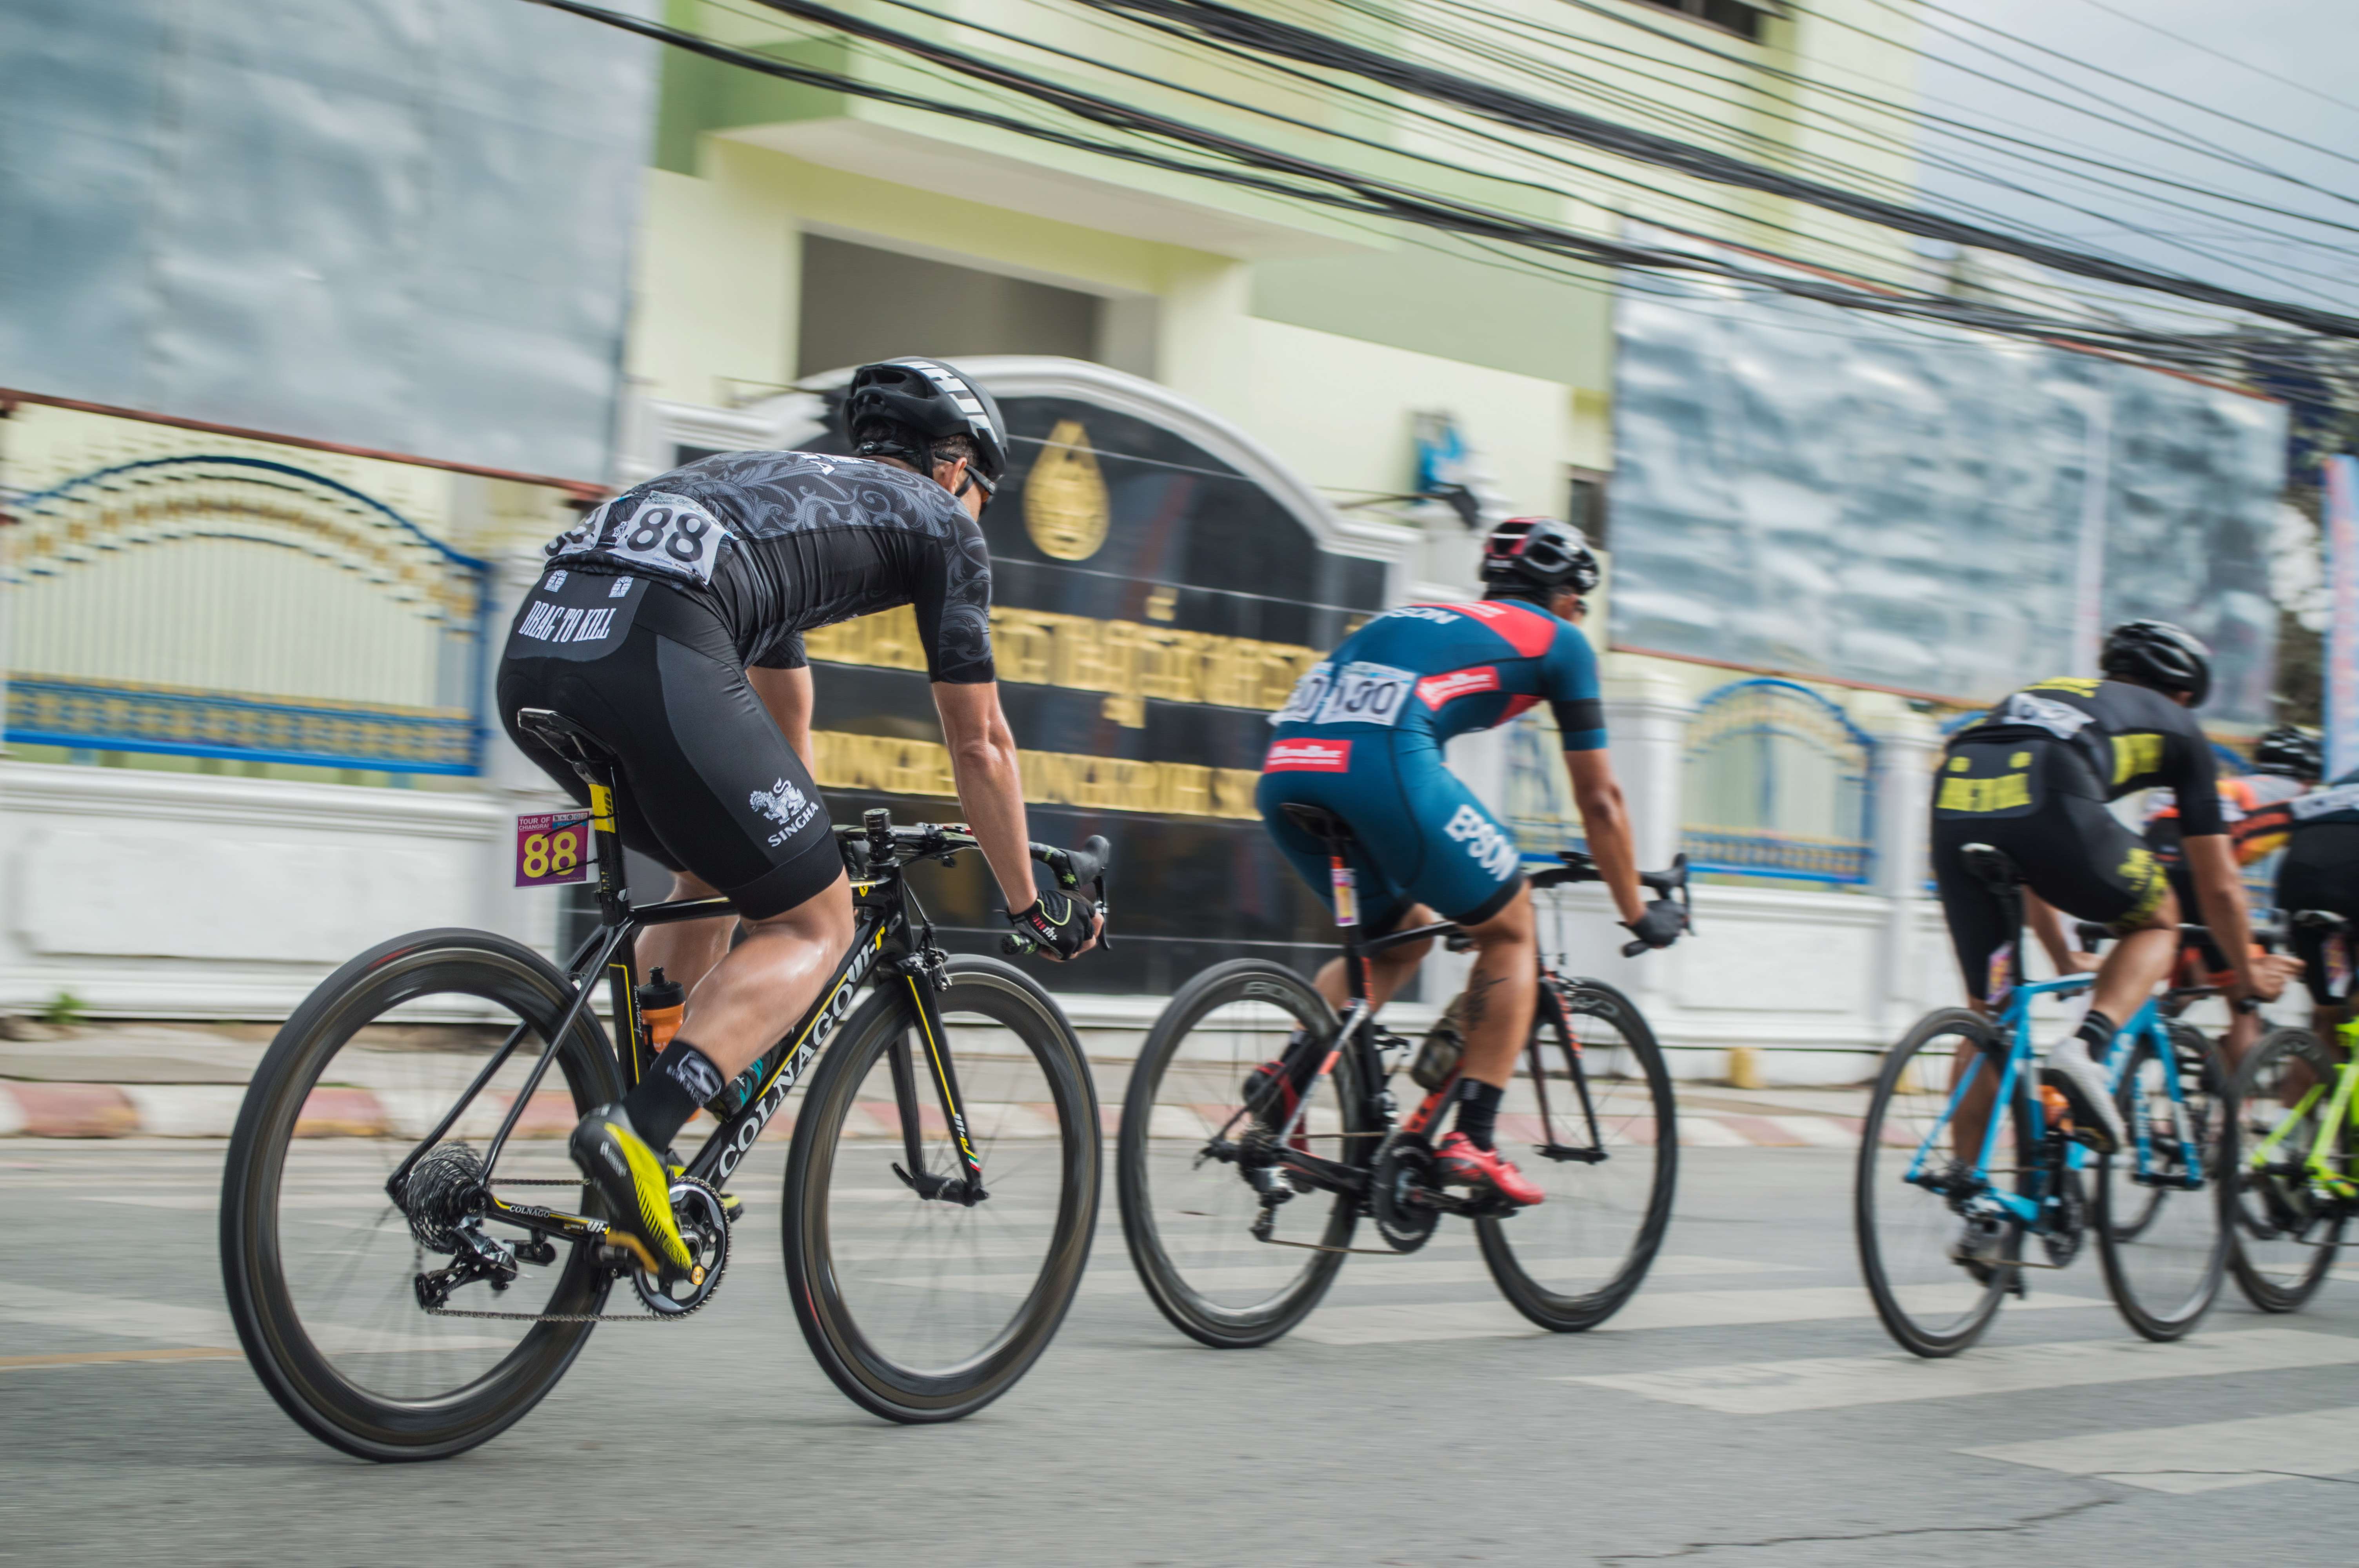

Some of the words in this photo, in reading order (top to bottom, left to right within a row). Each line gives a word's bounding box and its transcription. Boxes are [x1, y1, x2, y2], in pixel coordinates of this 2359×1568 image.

[627, 507, 712, 563] 88
[518, 601, 565, 641] DRAG
[552, 608, 584, 642] TO
[572, 608, 616, 642] KILL
[767, 802, 819, 847] SINGHA
[1443, 804, 1519, 882] EPSON
[523, 831, 577, 878] 88
[719, 978, 854, 1178] COLNAGO
[509, 1205, 550, 1218] COLNAGO
